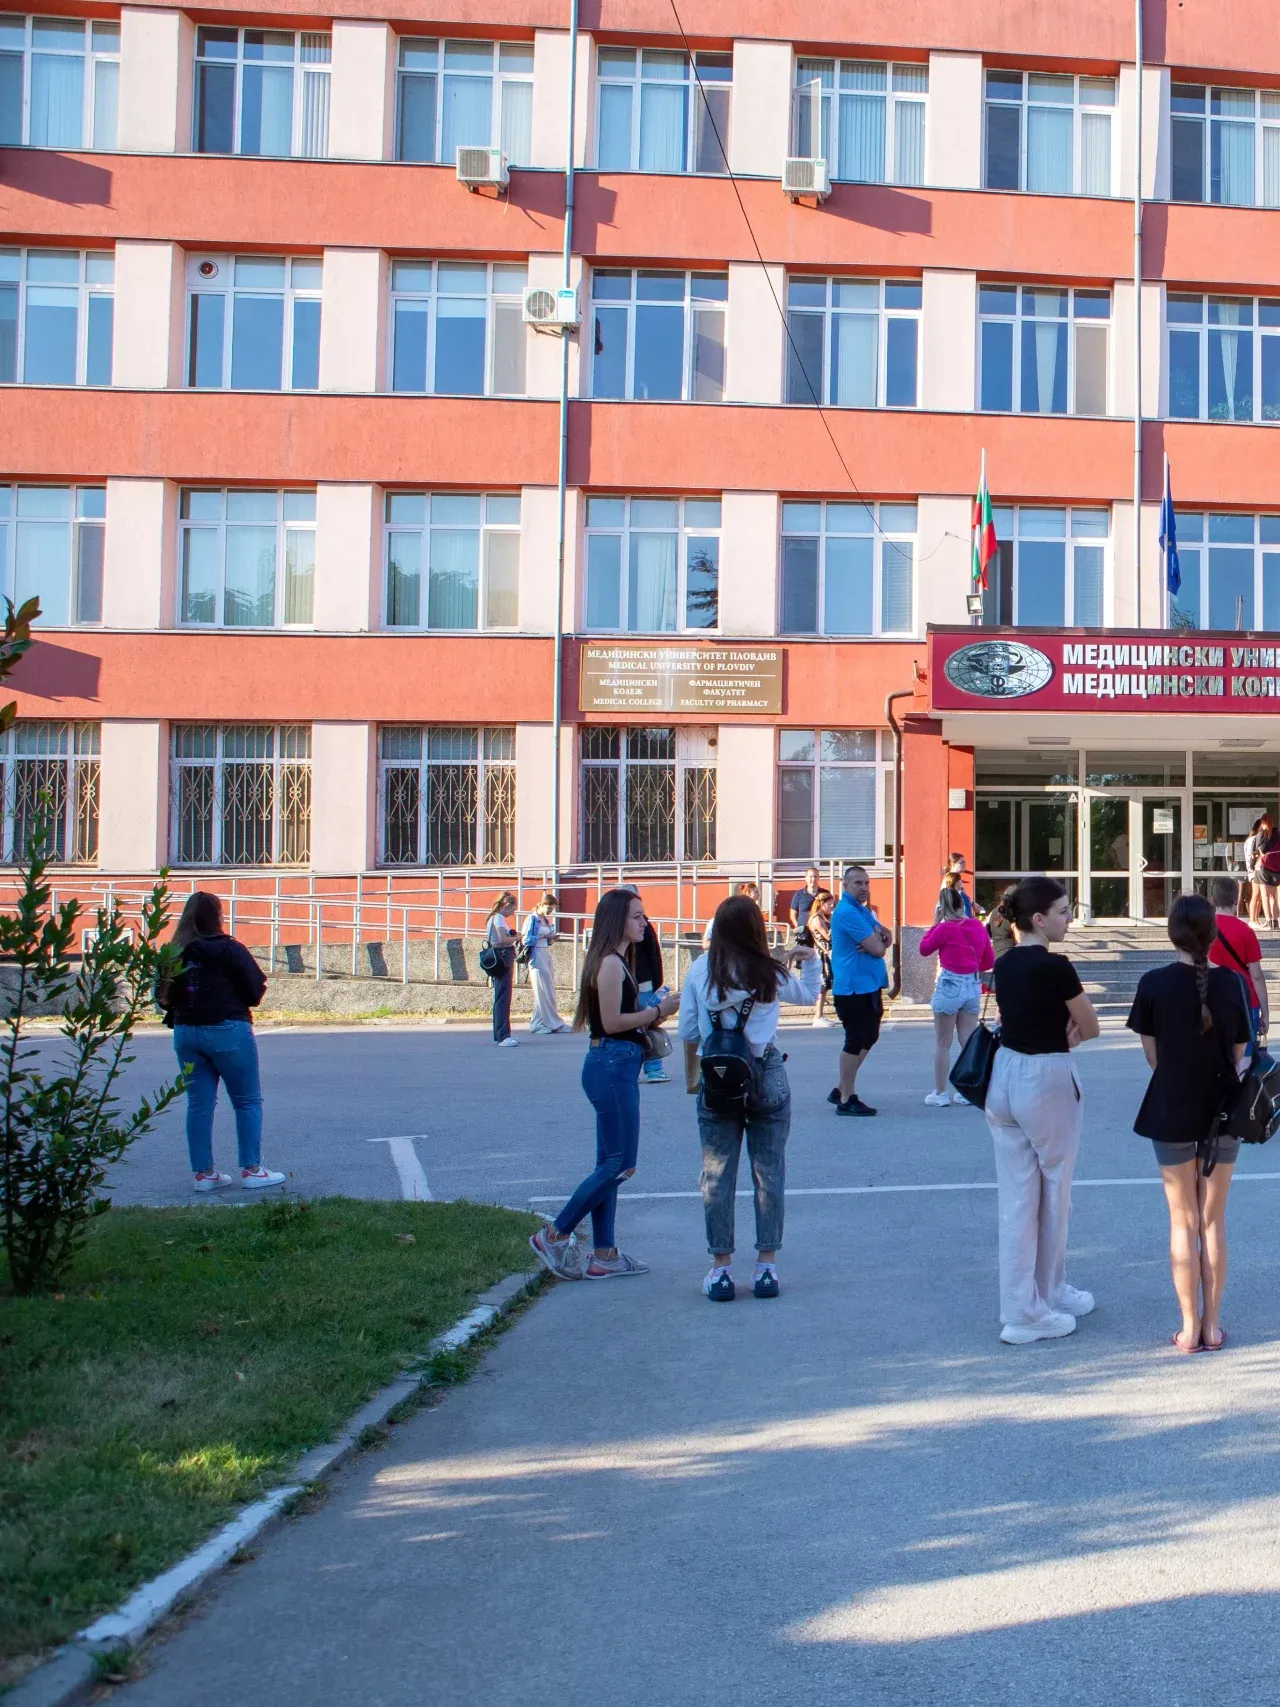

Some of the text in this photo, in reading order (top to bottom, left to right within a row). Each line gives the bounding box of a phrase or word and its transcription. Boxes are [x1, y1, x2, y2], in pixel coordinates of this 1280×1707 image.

[588, 650, 776, 662] МЕДИЦИНСКИ УНИВЕРСИТЕТ ПЛОВДИВ
[1063, 644, 1224, 669] МЕДИЦИНСКИ
[717, 663, 755, 671] PLOVDIV
[599, 679, 657, 688] МЕДИЦИНСКИ
[689, 680, 761, 688] ФАРМАЦЕВТИЧЕН
[1063, 673, 1224, 698] МЕДИЦИНСКИ
